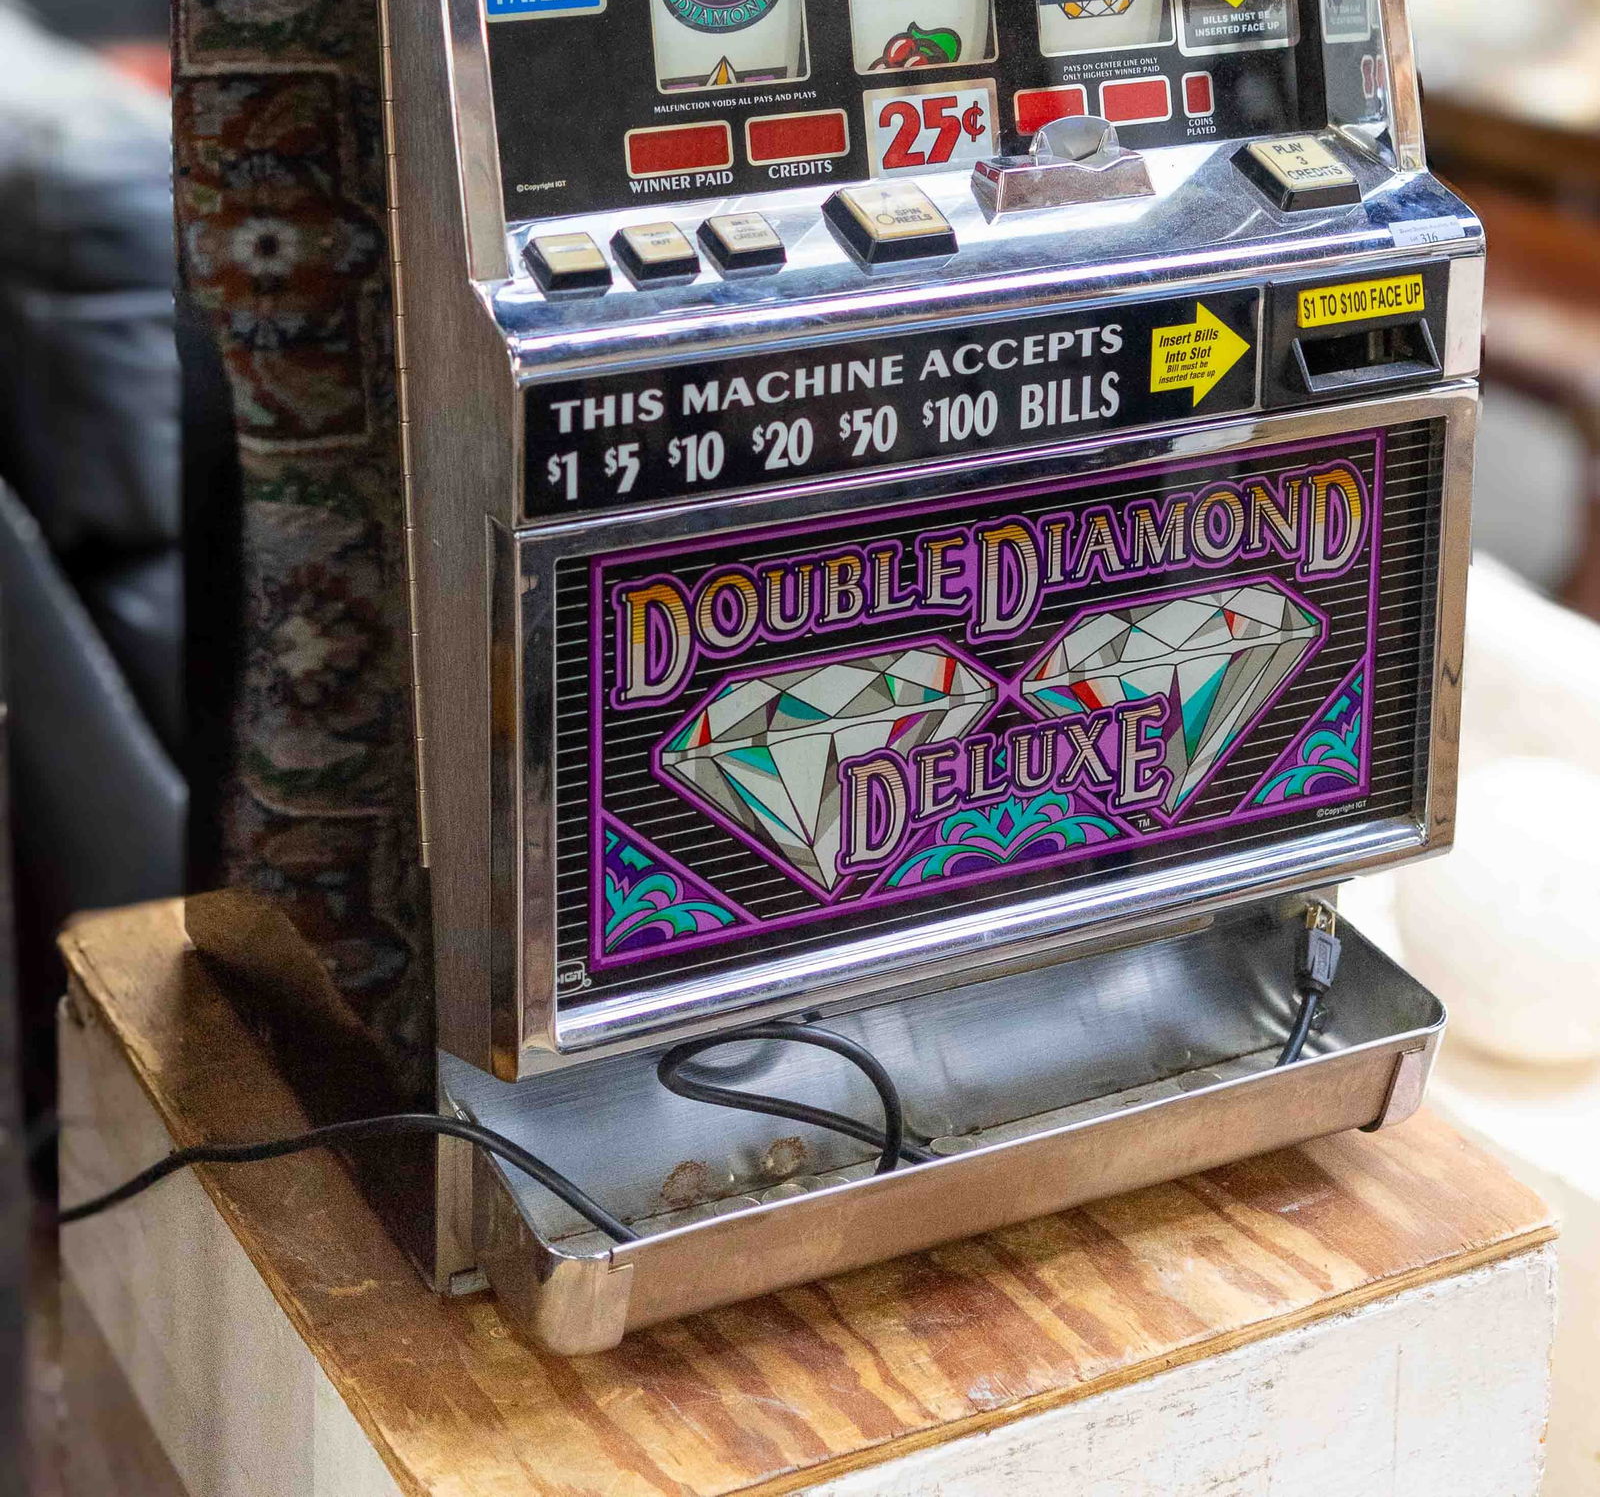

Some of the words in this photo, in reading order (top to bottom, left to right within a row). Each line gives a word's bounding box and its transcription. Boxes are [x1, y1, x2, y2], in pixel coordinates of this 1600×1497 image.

[1202, 14, 1228, 24] BILLS
[1230, 12, 1256, 22] MUST
[1258, 10, 1270, 19] BE
[1195, 25, 1239, 37] INSERTED
[1242, 23, 1265, 32] FACE
[1267, 22, 1279, 30] UP
[1063, 65, 1081, 73] PAYS
[1082, 63, 1093, 71] ON
[1095, 60, 1121, 70] CENTER
[1124, 59, 1138, 67] LINE
[1140, 57, 1158, 66] ONLY
[1063, 72, 1081, 81] ONLY
[1083, 70, 1113, 79] HIGHEST
[1114, 67, 1141, 76] WINNER
[1143, 65, 1160, 73] PAID
[654, 101, 710, 113] MALFUNCTION
[712, 98, 736, 107] VOIDS
[738, 97, 752, 105] ALL
[754, 95, 773, 104] PAYS
[775, 93, 791, 102] AND
[794, 90, 817, 100] PLAYS
[1188, 117, 1214, 126] COINS
[879, 95, 985, 170] 25¢
[1187, 126, 1216, 136] PLAYED
[1273, 142, 1305, 155] PLAY
[1297, 156, 1308, 165] 3
[768, 160, 833, 179] CREDITS
[1287, 166, 1345, 181] CREDITS
[629, 174, 690, 194] WINNER
[696, 171, 734, 187] PAID
[895, 207, 922, 215] SPIN
[1303, 297, 1317, 320] $1
[1320, 295, 1337, 317] TO
[1341, 290, 1367, 314] $100
[1371, 285, 1403, 310] FACE
[1405, 282, 1422, 305] UP
[1159, 331, 1192, 348] Insert
[1194, 328, 1218, 344] Bills
[1165, 350, 1186, 364] Into
[1188, 346, 1211, 361] Slot
[1166, 363, 1179, 373] Bill
[1180, 362, 1197, 371] must
[1199, 360, 1208, 369] be
[550, 389, 664, 434] THIS
[682, 355, 904, 416] MACHINE
[919, 324, 1123, 381] ACCEPTS
[1158, 372, 1188, 384] inserted
[1189, 370, 1205, 381] face
[1206, 369, 1216, 379] up
[548, 451, 578, 501] $1
[604, 443, 640, 494] $5
[668, 431, 725, 483] $10
[752, 417, 814, 470] $20
[839, 405, 898, 457] $50
[922, 390, 998, 443] $100
[1020, 371, 1120, 430] BILLS
[619, 536, 968, 702] DOUBLE
[975, 468, 1362, 634] DIAMOND
[845, 702, 1165, 865] DELUXE
